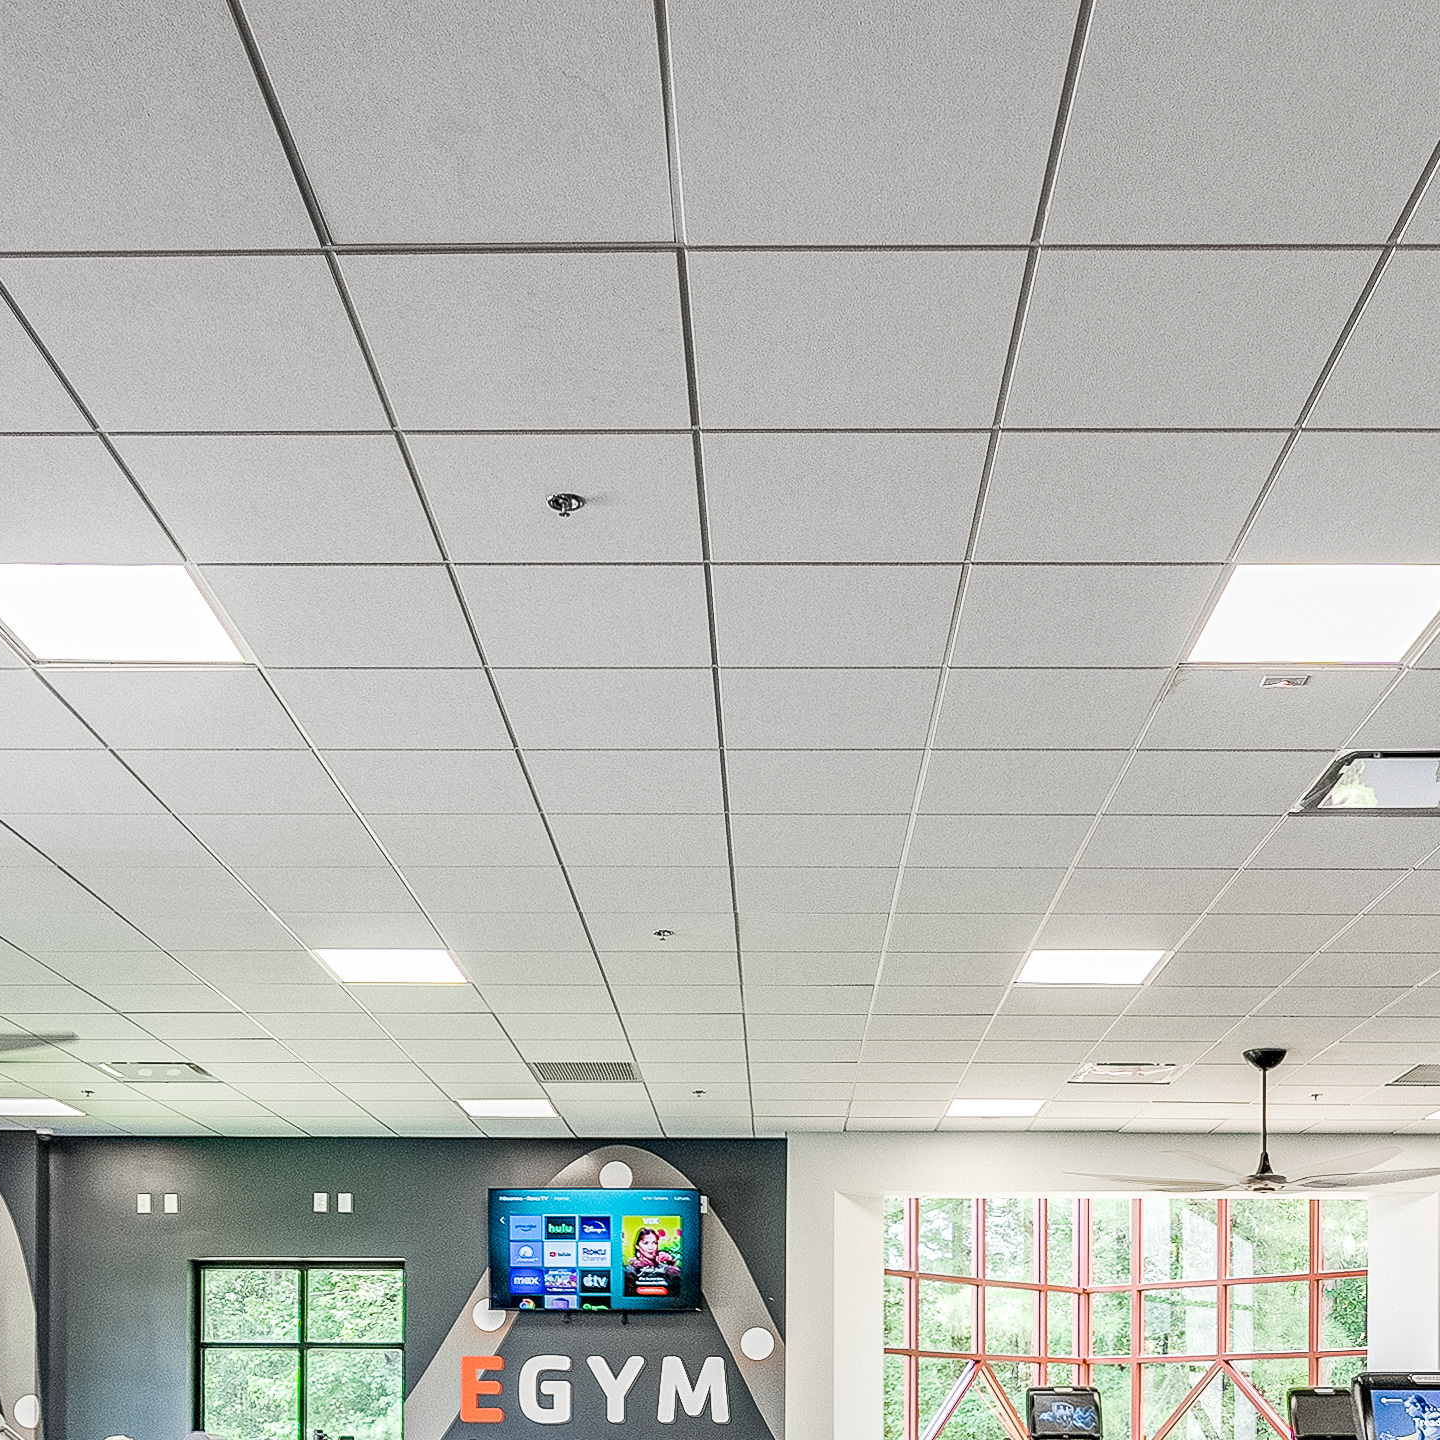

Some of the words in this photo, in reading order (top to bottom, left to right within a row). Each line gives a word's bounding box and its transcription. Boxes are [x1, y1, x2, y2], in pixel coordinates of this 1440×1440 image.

[548, 1223, 574, 1233] hulu
[582, 1247, 607, 1255] Roku
[513, 1276, 539, 1285] max
[460, 1354, 731, 1425] EGYM
